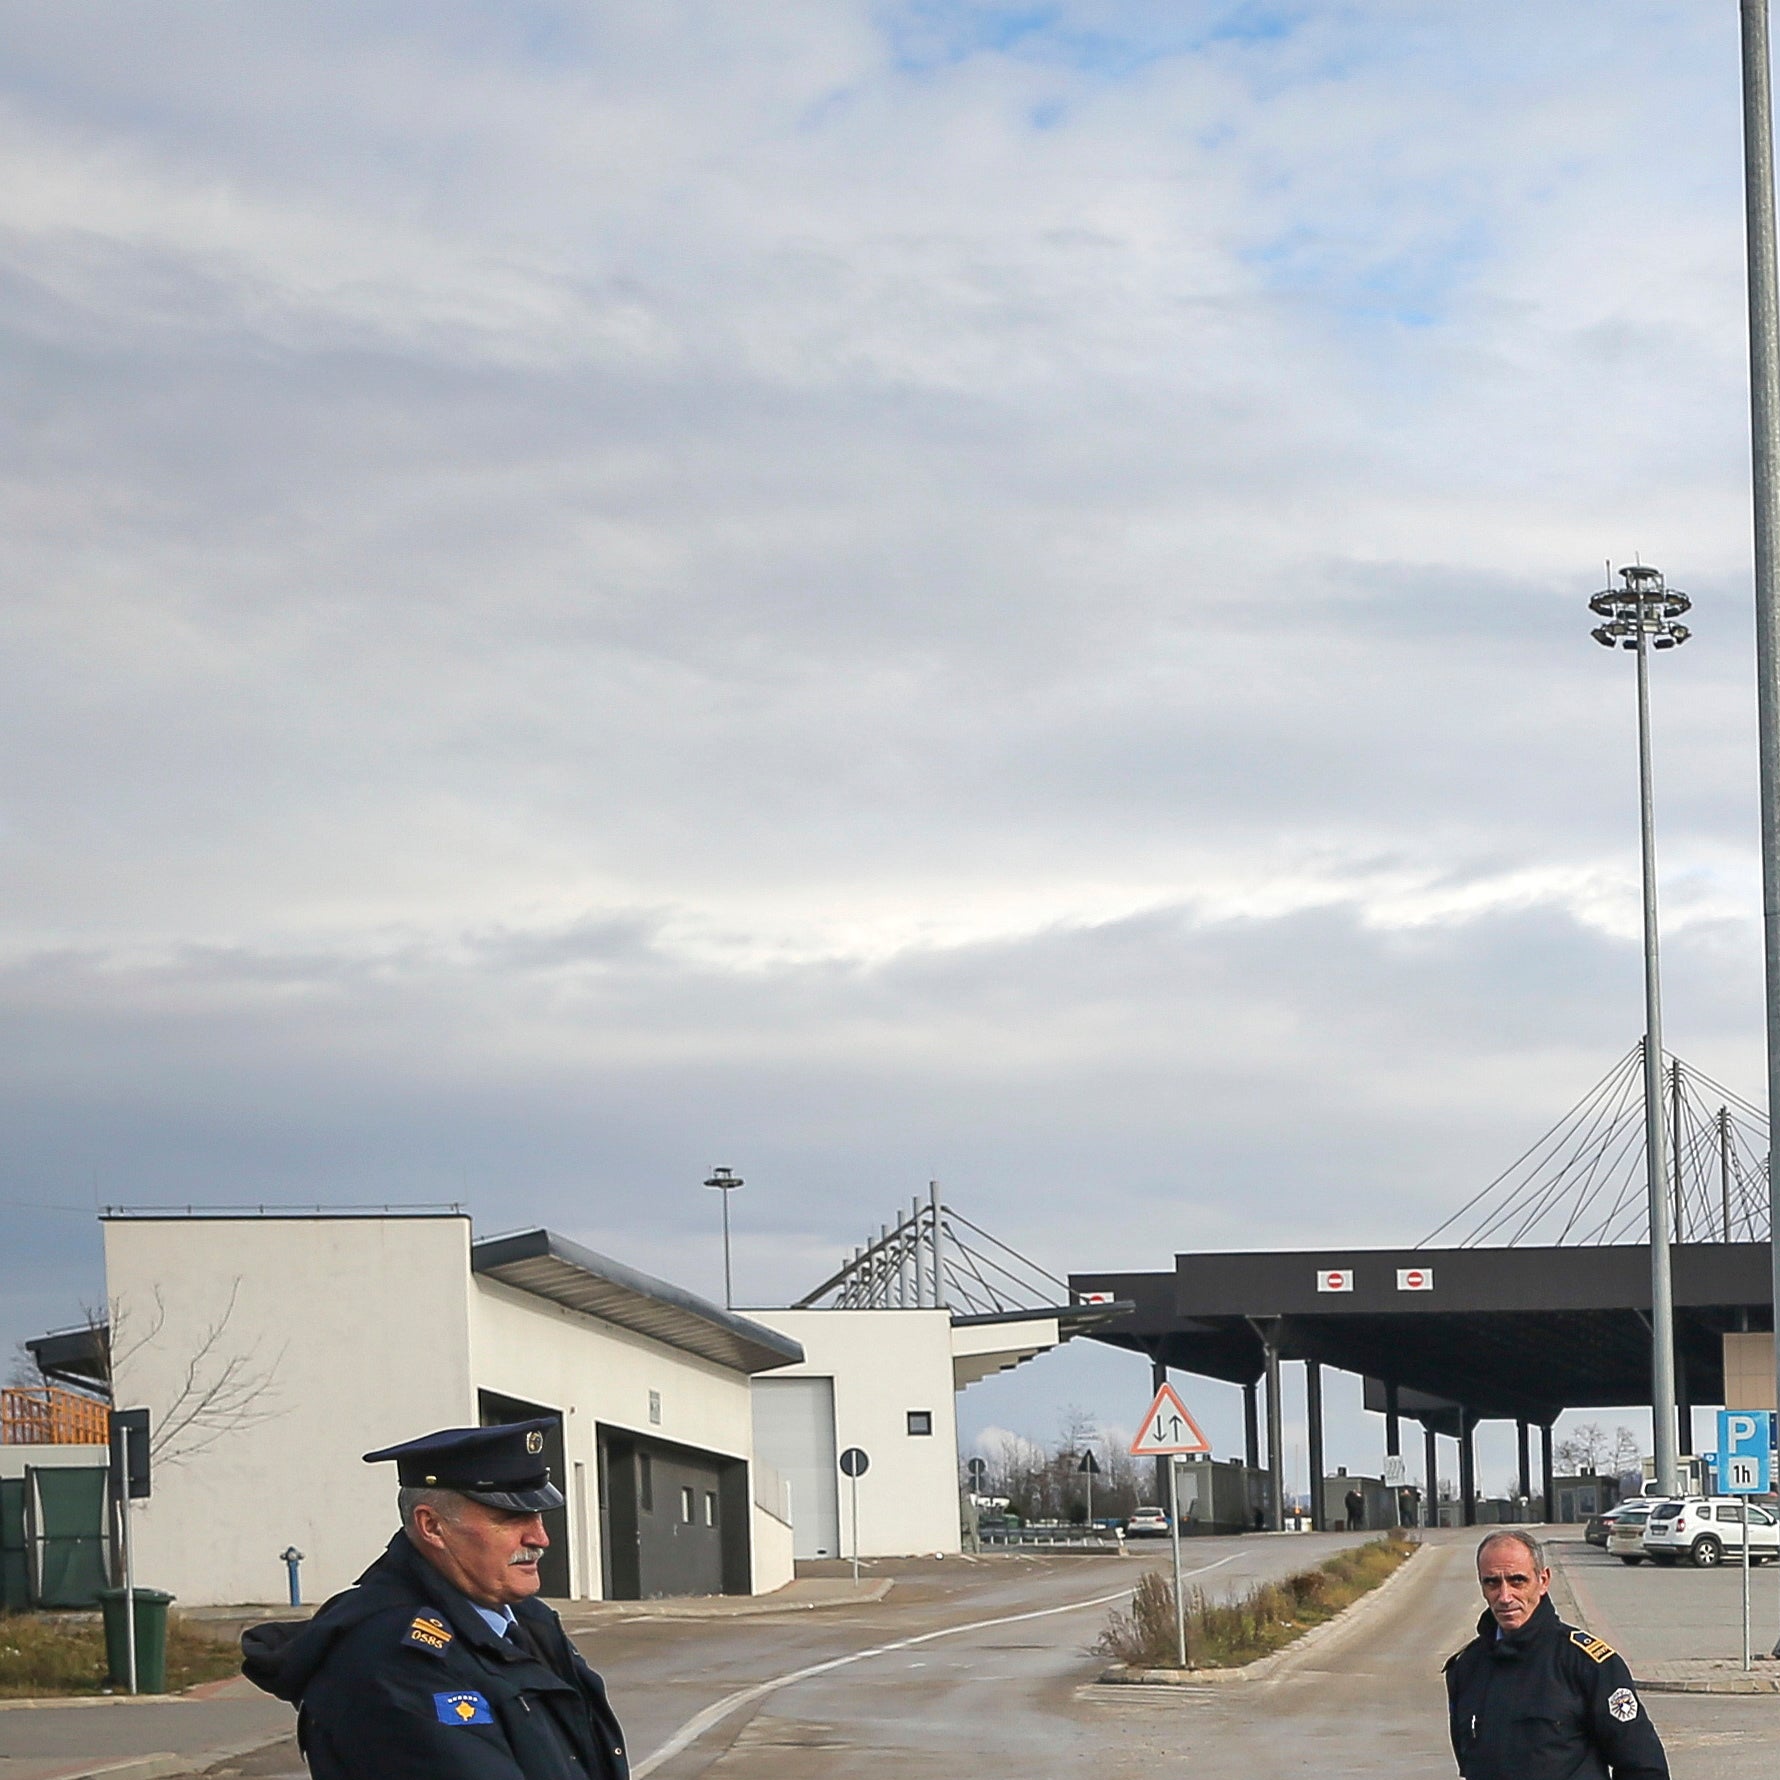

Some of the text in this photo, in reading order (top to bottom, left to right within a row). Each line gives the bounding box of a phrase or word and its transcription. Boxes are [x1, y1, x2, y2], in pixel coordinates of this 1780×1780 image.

[1728, 1415, 1756, 1454] P
[1733, 1464, 1751, 1484] 1h
[411, 1630, 445, 1649] 0585
